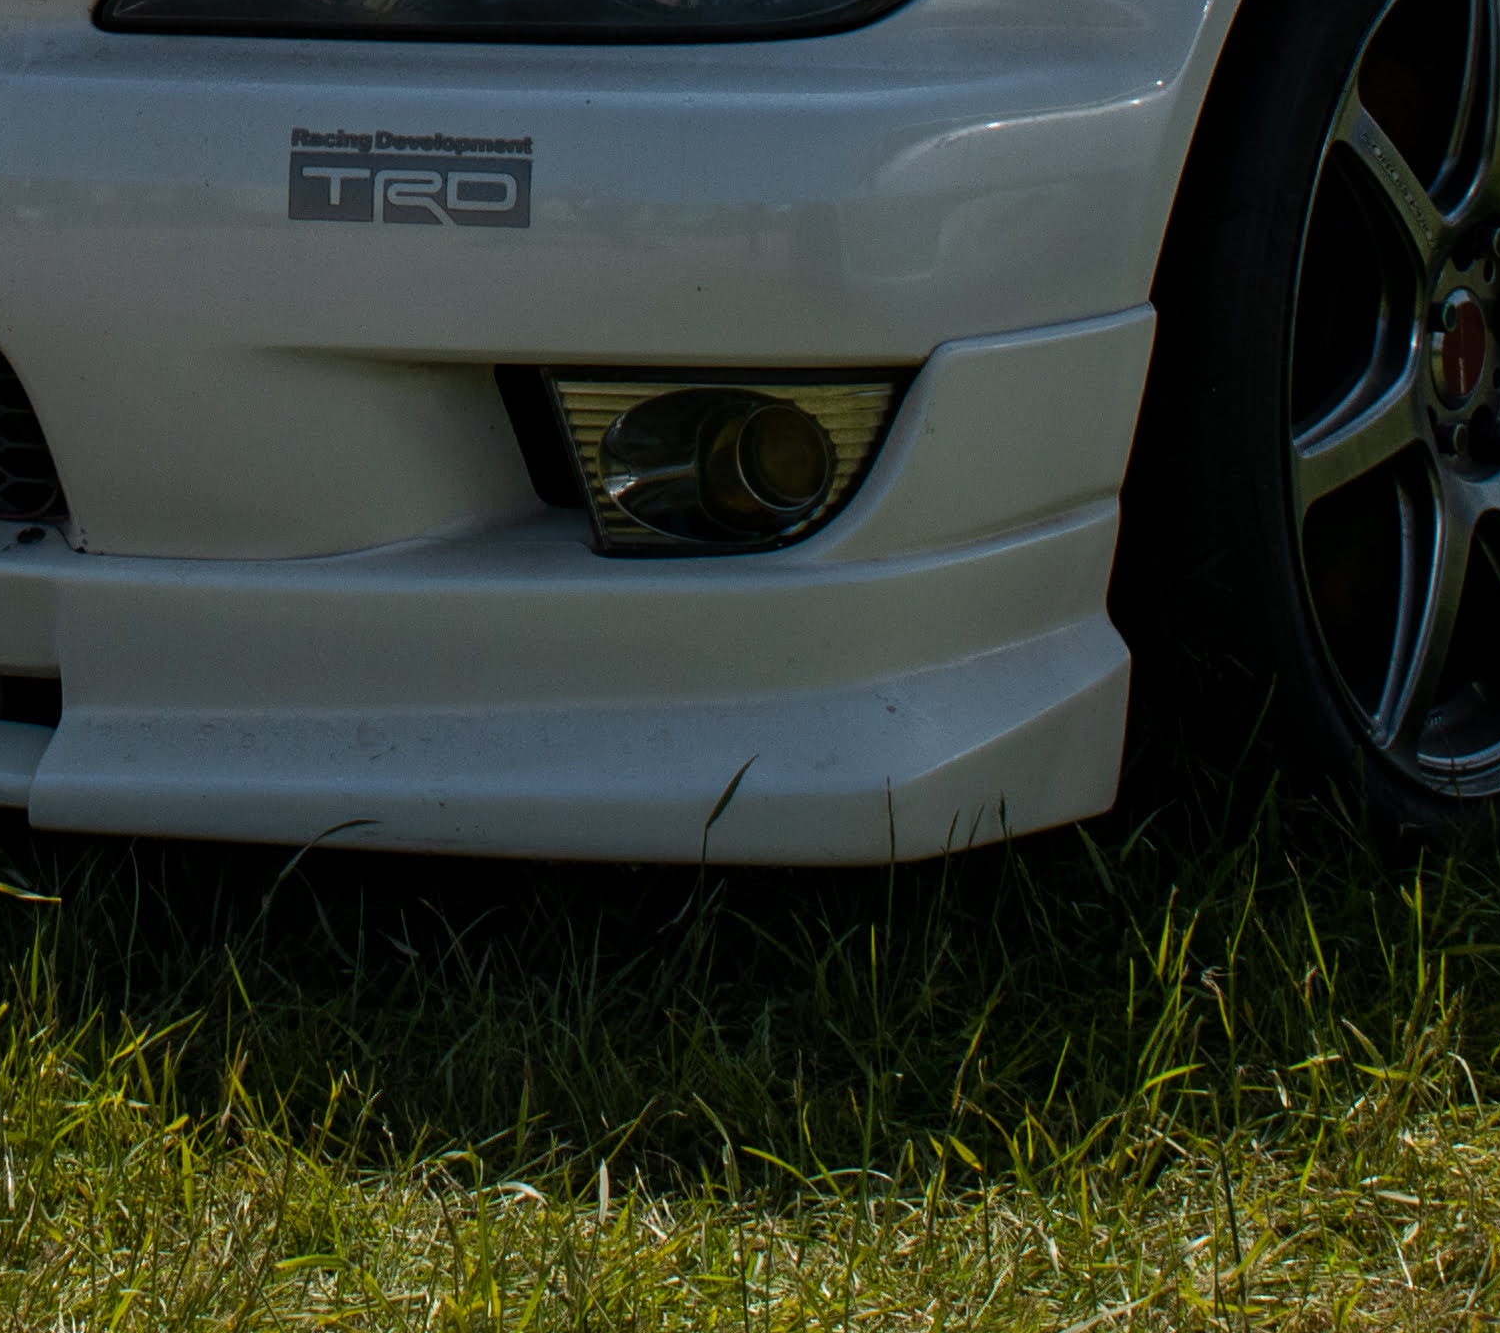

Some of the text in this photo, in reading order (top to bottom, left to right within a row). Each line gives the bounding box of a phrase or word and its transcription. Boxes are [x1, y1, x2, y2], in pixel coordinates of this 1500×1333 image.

[291, 127, 534, 155] Racing Development
[301, 166, 519, 227] TRD
